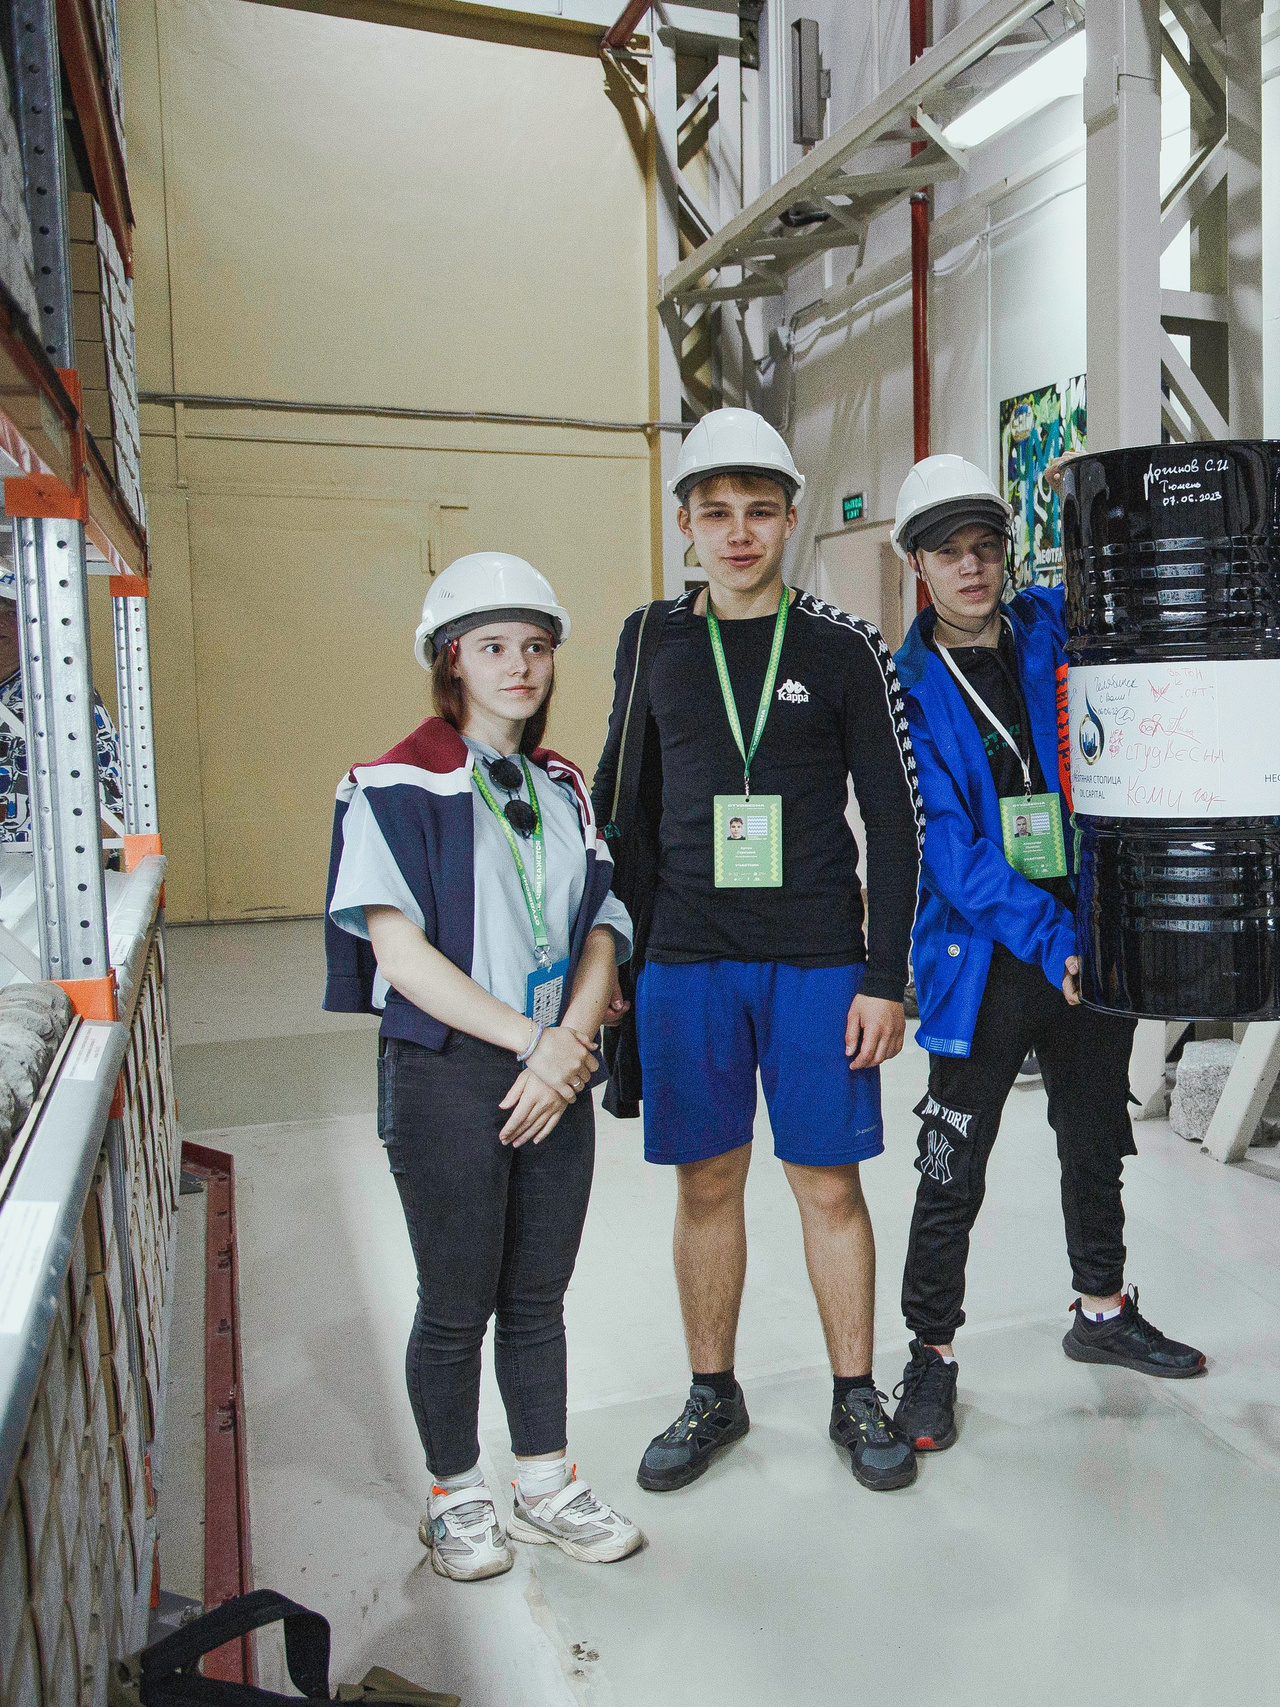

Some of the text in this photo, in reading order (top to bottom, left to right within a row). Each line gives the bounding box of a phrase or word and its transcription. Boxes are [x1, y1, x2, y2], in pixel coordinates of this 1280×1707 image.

[1162, 491, 1223, 507] 07.06.2023
[778, 691, 810, 704] Kappa
[941, 1106, 972, 1138] YORK
